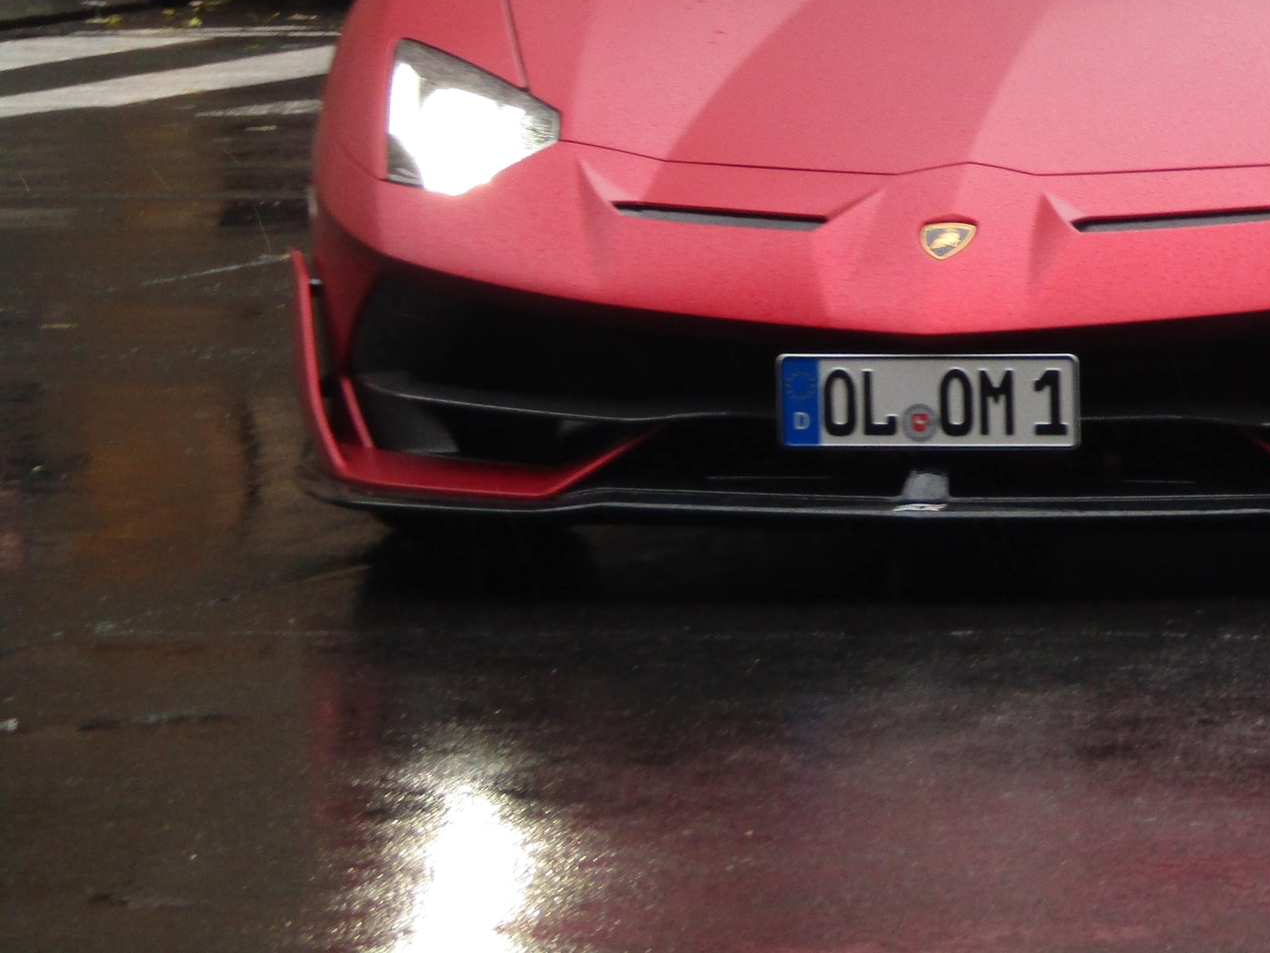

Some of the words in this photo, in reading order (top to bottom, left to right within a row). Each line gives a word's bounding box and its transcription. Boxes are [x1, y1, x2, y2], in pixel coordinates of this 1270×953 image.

[793, 411, 811, 430] D
[824, 366, 898, 437] OL
[940, 366, 1014, 437] OM
[1034, 367, 1069, 436] 1
